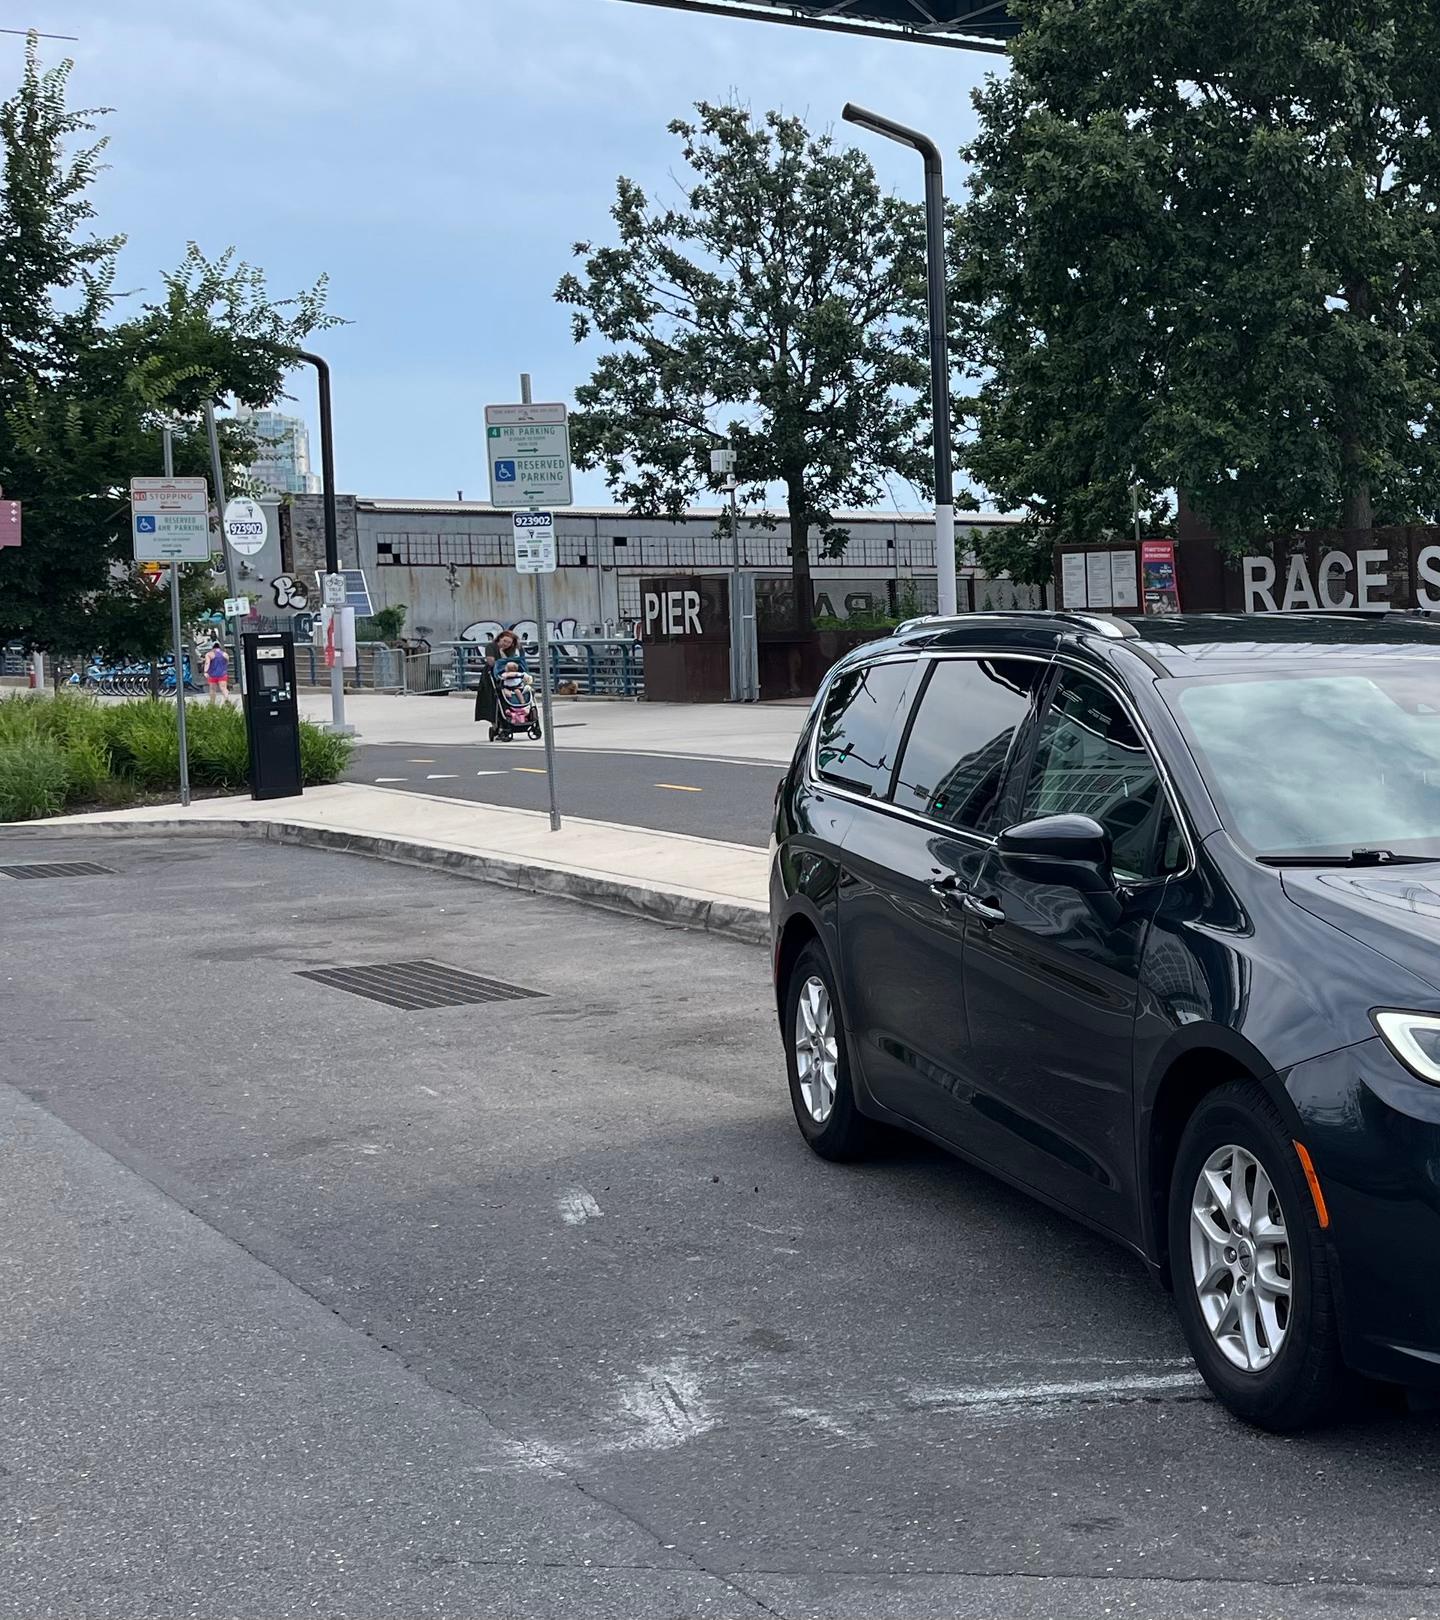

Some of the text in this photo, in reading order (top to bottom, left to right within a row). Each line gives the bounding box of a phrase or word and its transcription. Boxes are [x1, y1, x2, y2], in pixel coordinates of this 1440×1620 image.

[520, 427, 555, 436] PARKING
[517, 460, 565, 470] RESERVED
[521, 472, 563, 481] PARKING
[516, 516, 551, 526] 923902
[230, 523, 262, 534] 923902
[1242, 550, 1391, 614] RACE
[645, 590, 703, 635] PIER
